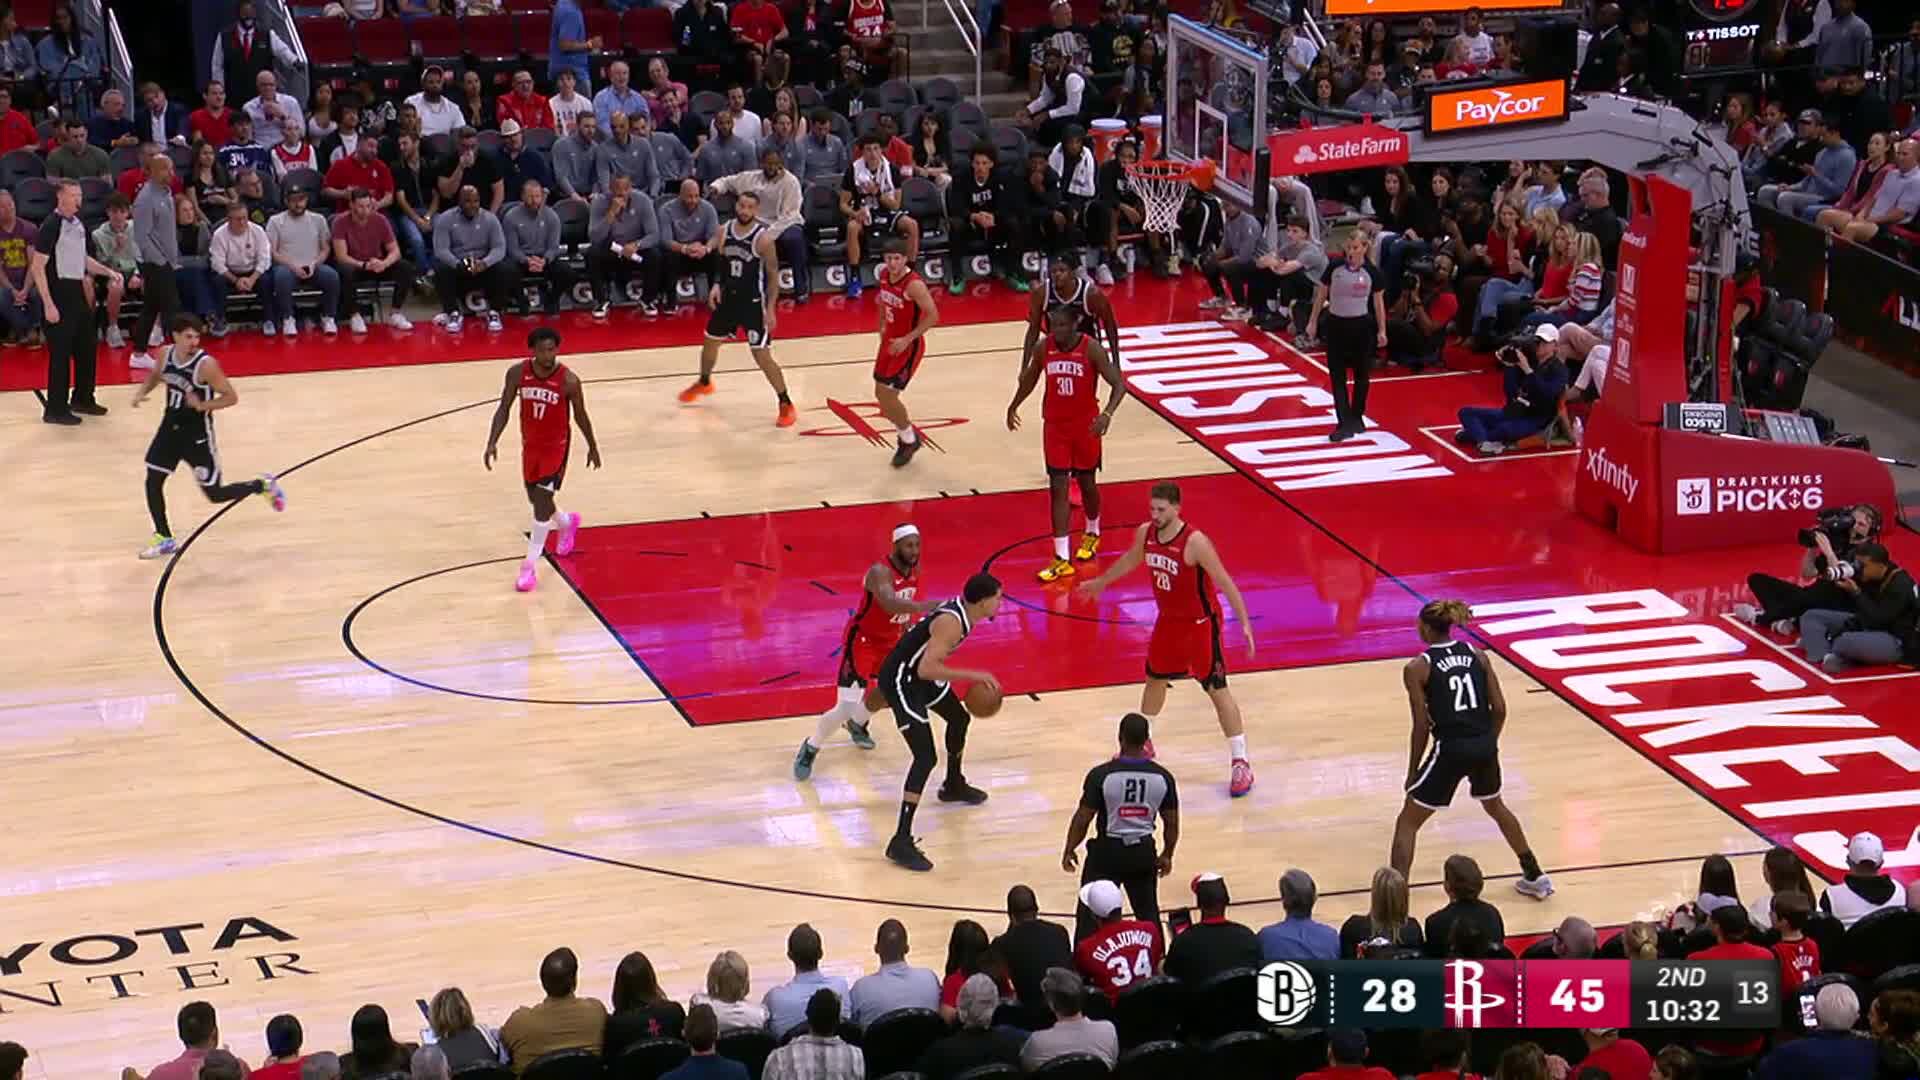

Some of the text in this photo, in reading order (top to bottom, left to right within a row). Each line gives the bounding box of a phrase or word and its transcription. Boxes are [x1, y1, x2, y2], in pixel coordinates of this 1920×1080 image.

[1707, 25, 1760, 40] TISSOT
[1456, 96, 1545, 123] Paycor
[826, 265, 846, 286] G
[1057, 377, 1074, 396] 30
[533, 401, 547, 420] 17
[1716, 474, 1823, 487] DRAFTKINGS
[1449, 672, 1478, 711] 21
[1124, 779, 1146, 803] 21
[1092, 930, 1153, 962] OLAJUWON
[1106, 948, 1153, 987] 34
